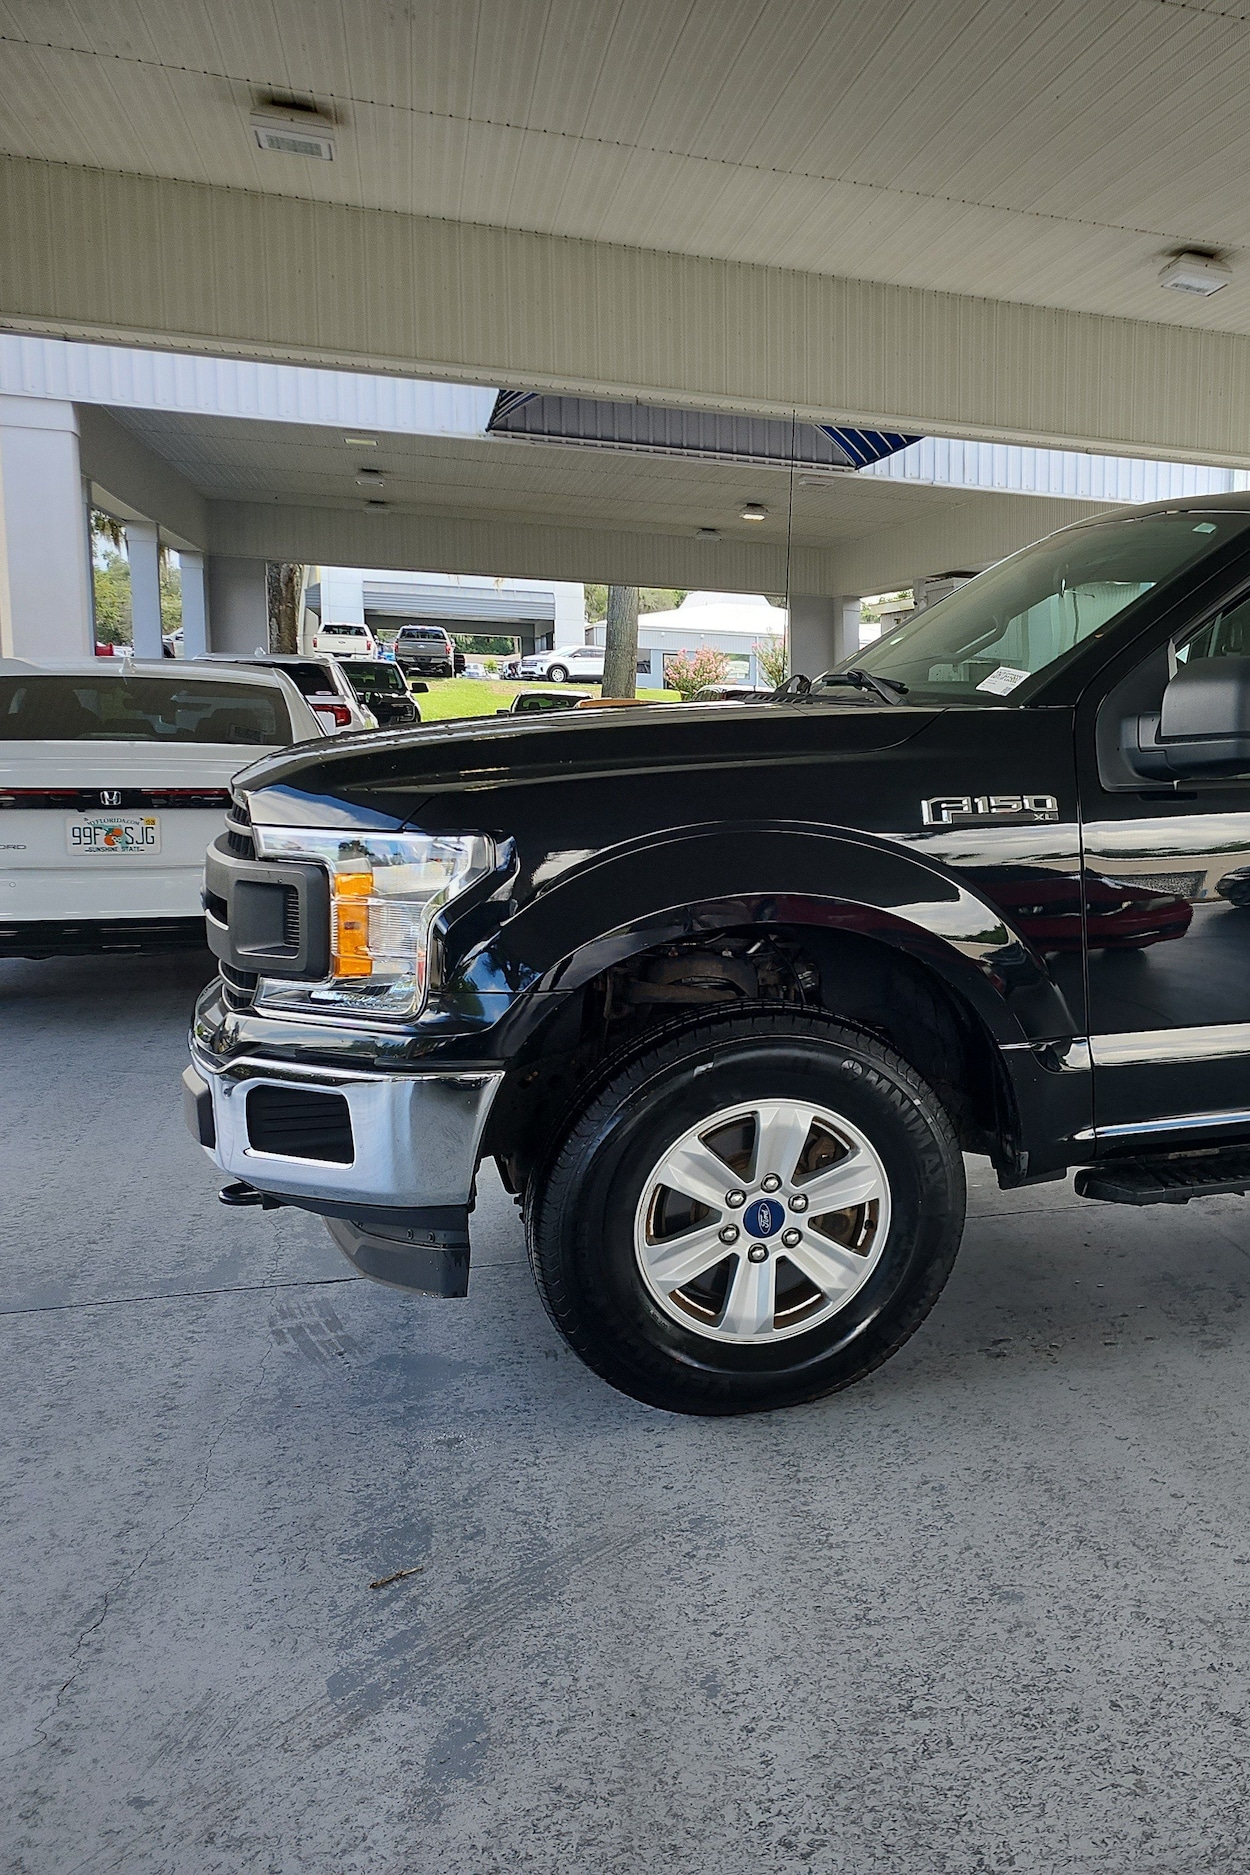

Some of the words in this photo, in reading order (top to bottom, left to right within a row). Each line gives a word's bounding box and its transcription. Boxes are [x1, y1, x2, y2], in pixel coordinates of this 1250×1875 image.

[1033, 813, 1054, 821] XL
[72, 826, 102, 845] 99F
[124, 826, 155, 845] SJG
